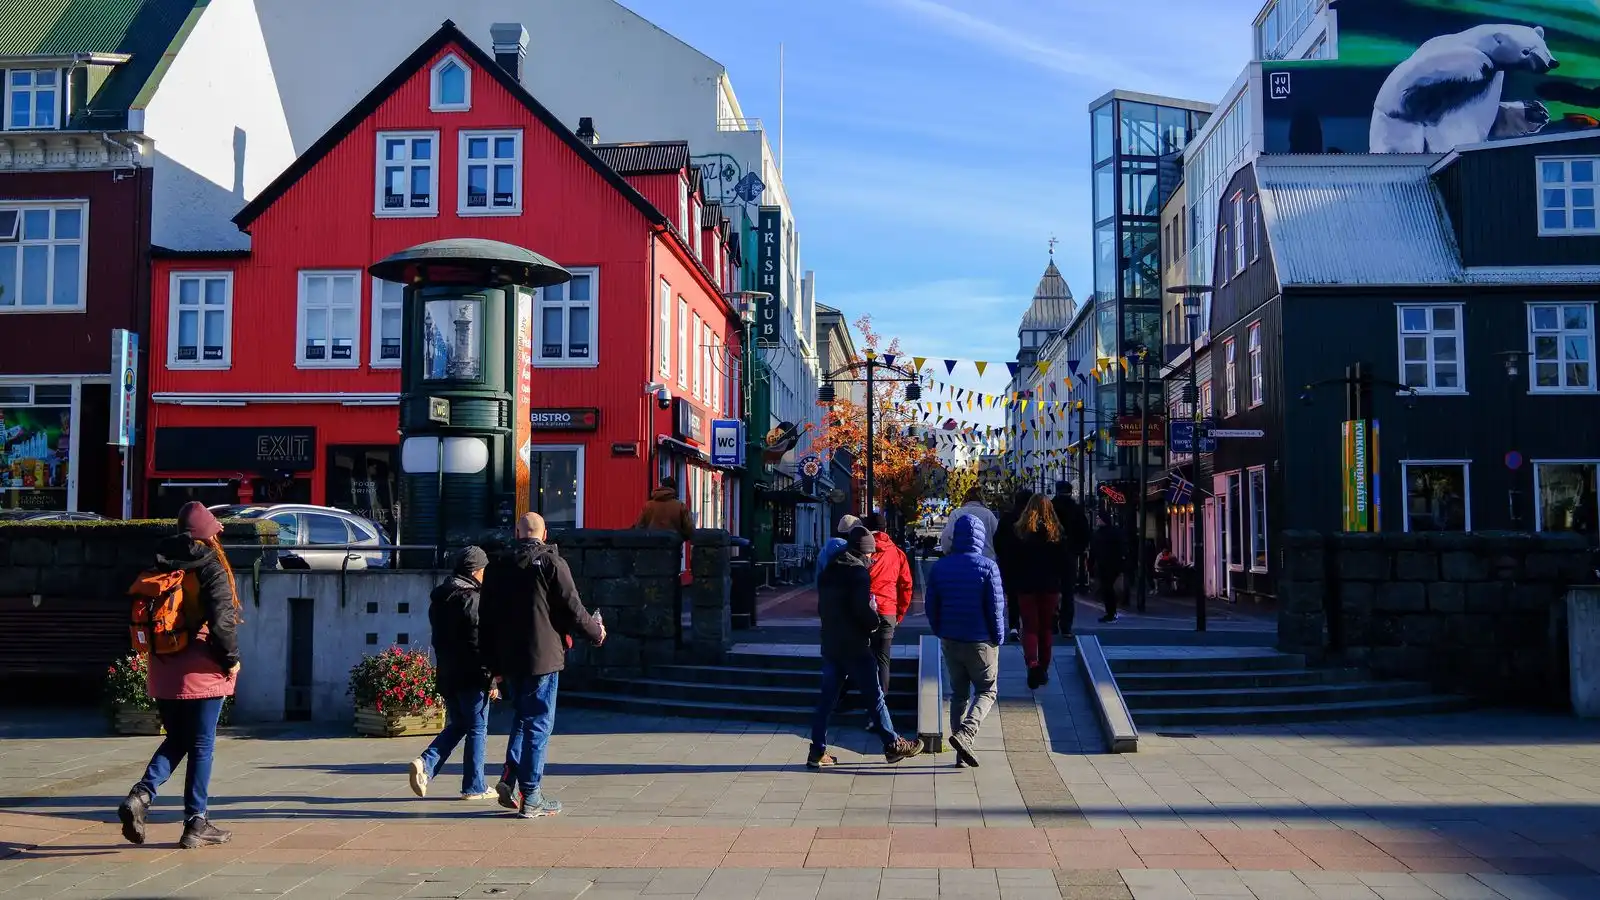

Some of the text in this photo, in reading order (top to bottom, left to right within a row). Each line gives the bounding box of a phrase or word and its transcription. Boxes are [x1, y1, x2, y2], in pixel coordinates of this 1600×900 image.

[763, 218, 774, 335] IRISH PUB
[436, 404, 446, 416] WC
[531, 413, 571, 422] BISTRO
[1119, 423, 1161, 431] SHALIAR
[257, 435, 309, 456] EXIT
[717, 437, 736, 448] WC
